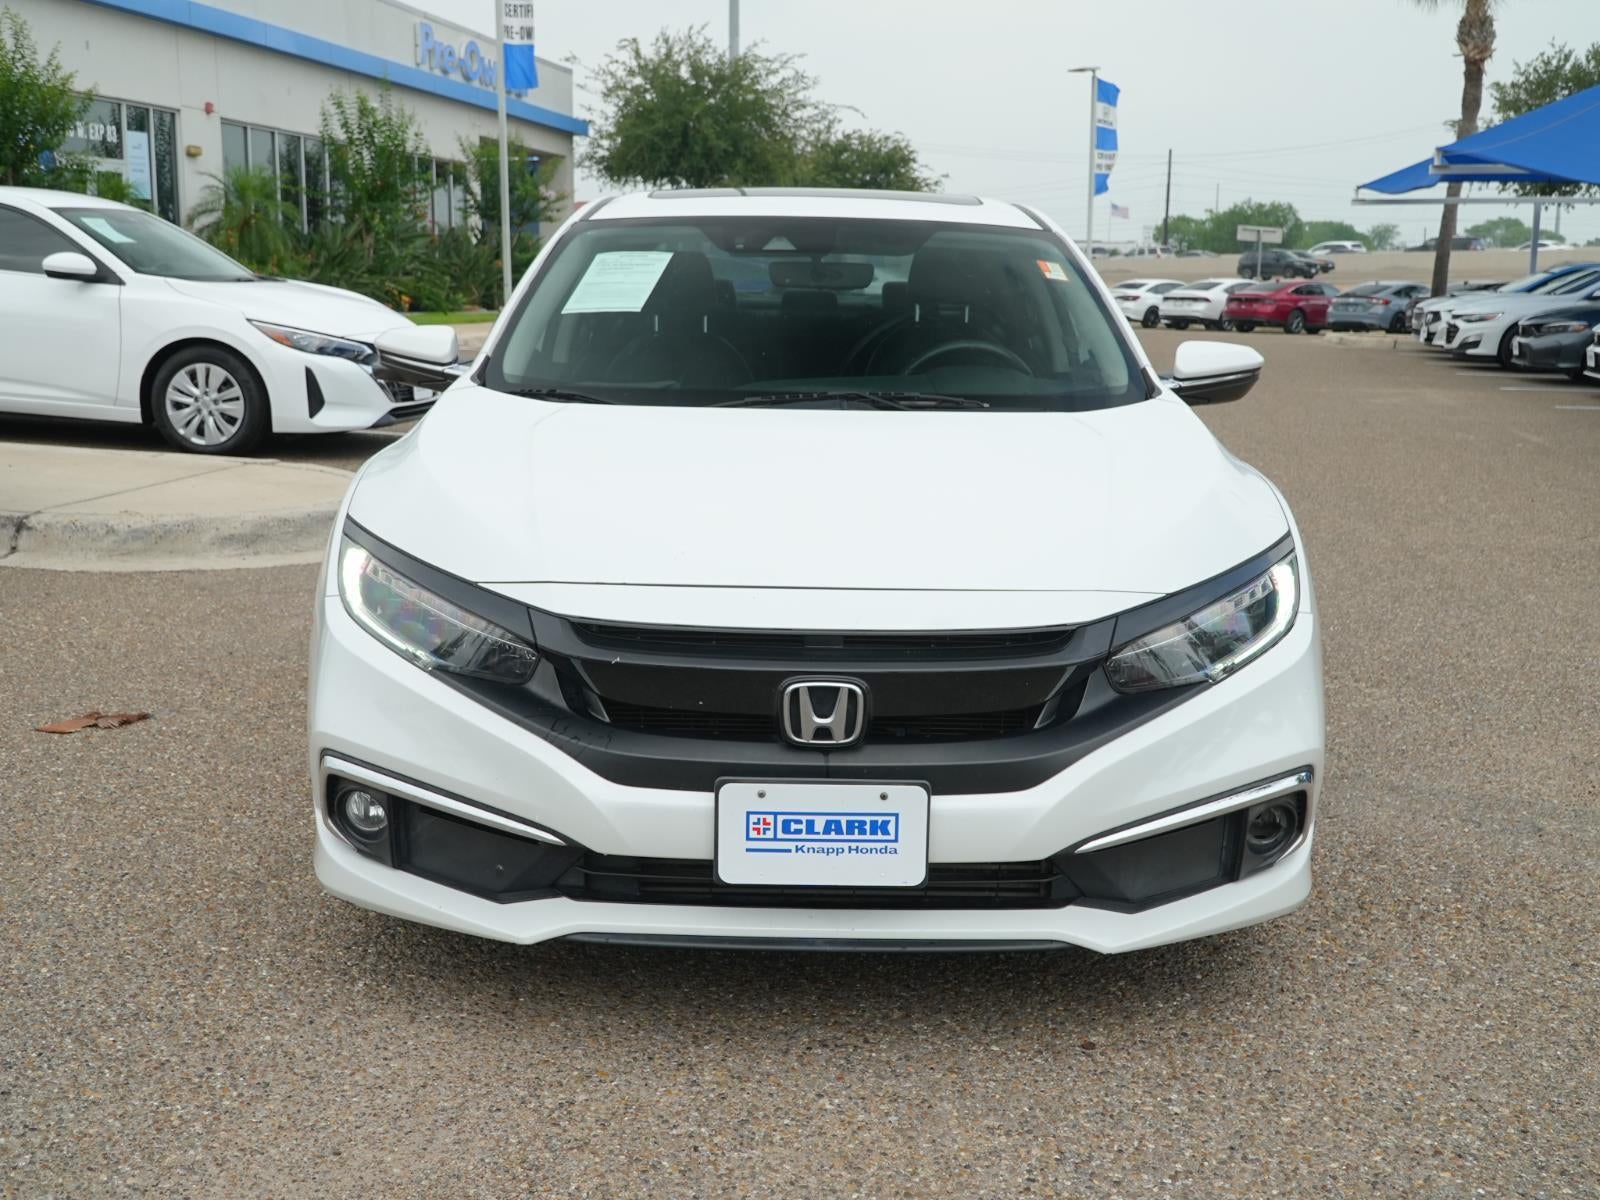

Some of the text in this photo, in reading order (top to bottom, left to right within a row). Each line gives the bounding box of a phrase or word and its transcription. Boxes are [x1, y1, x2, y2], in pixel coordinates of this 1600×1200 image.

[89, 123, 104, 141] EXP
[781, 818, 892, 836] CLARK
[794, 844, 898, 856] Knapp Honda
